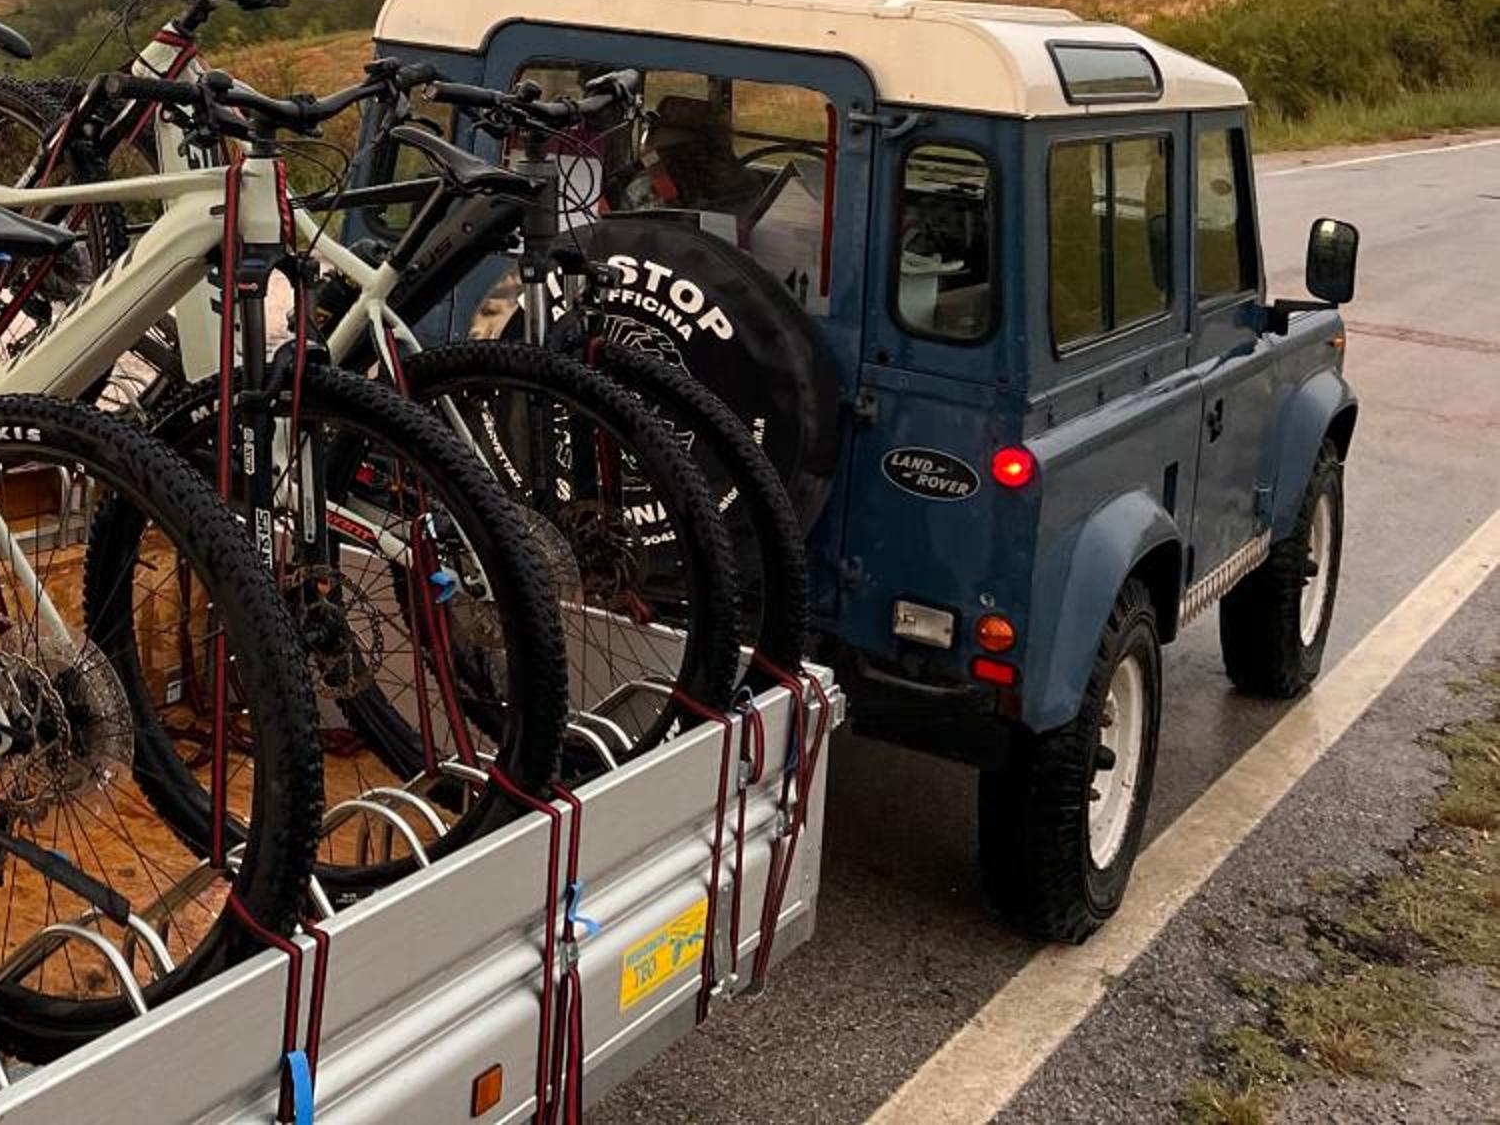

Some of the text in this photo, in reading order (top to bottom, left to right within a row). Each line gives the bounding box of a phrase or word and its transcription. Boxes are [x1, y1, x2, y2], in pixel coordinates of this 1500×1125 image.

[606, 254, 735, 341] STOP
[890, 454, 934, 472] LAND
[915, 474, 970, 495] ROVER
